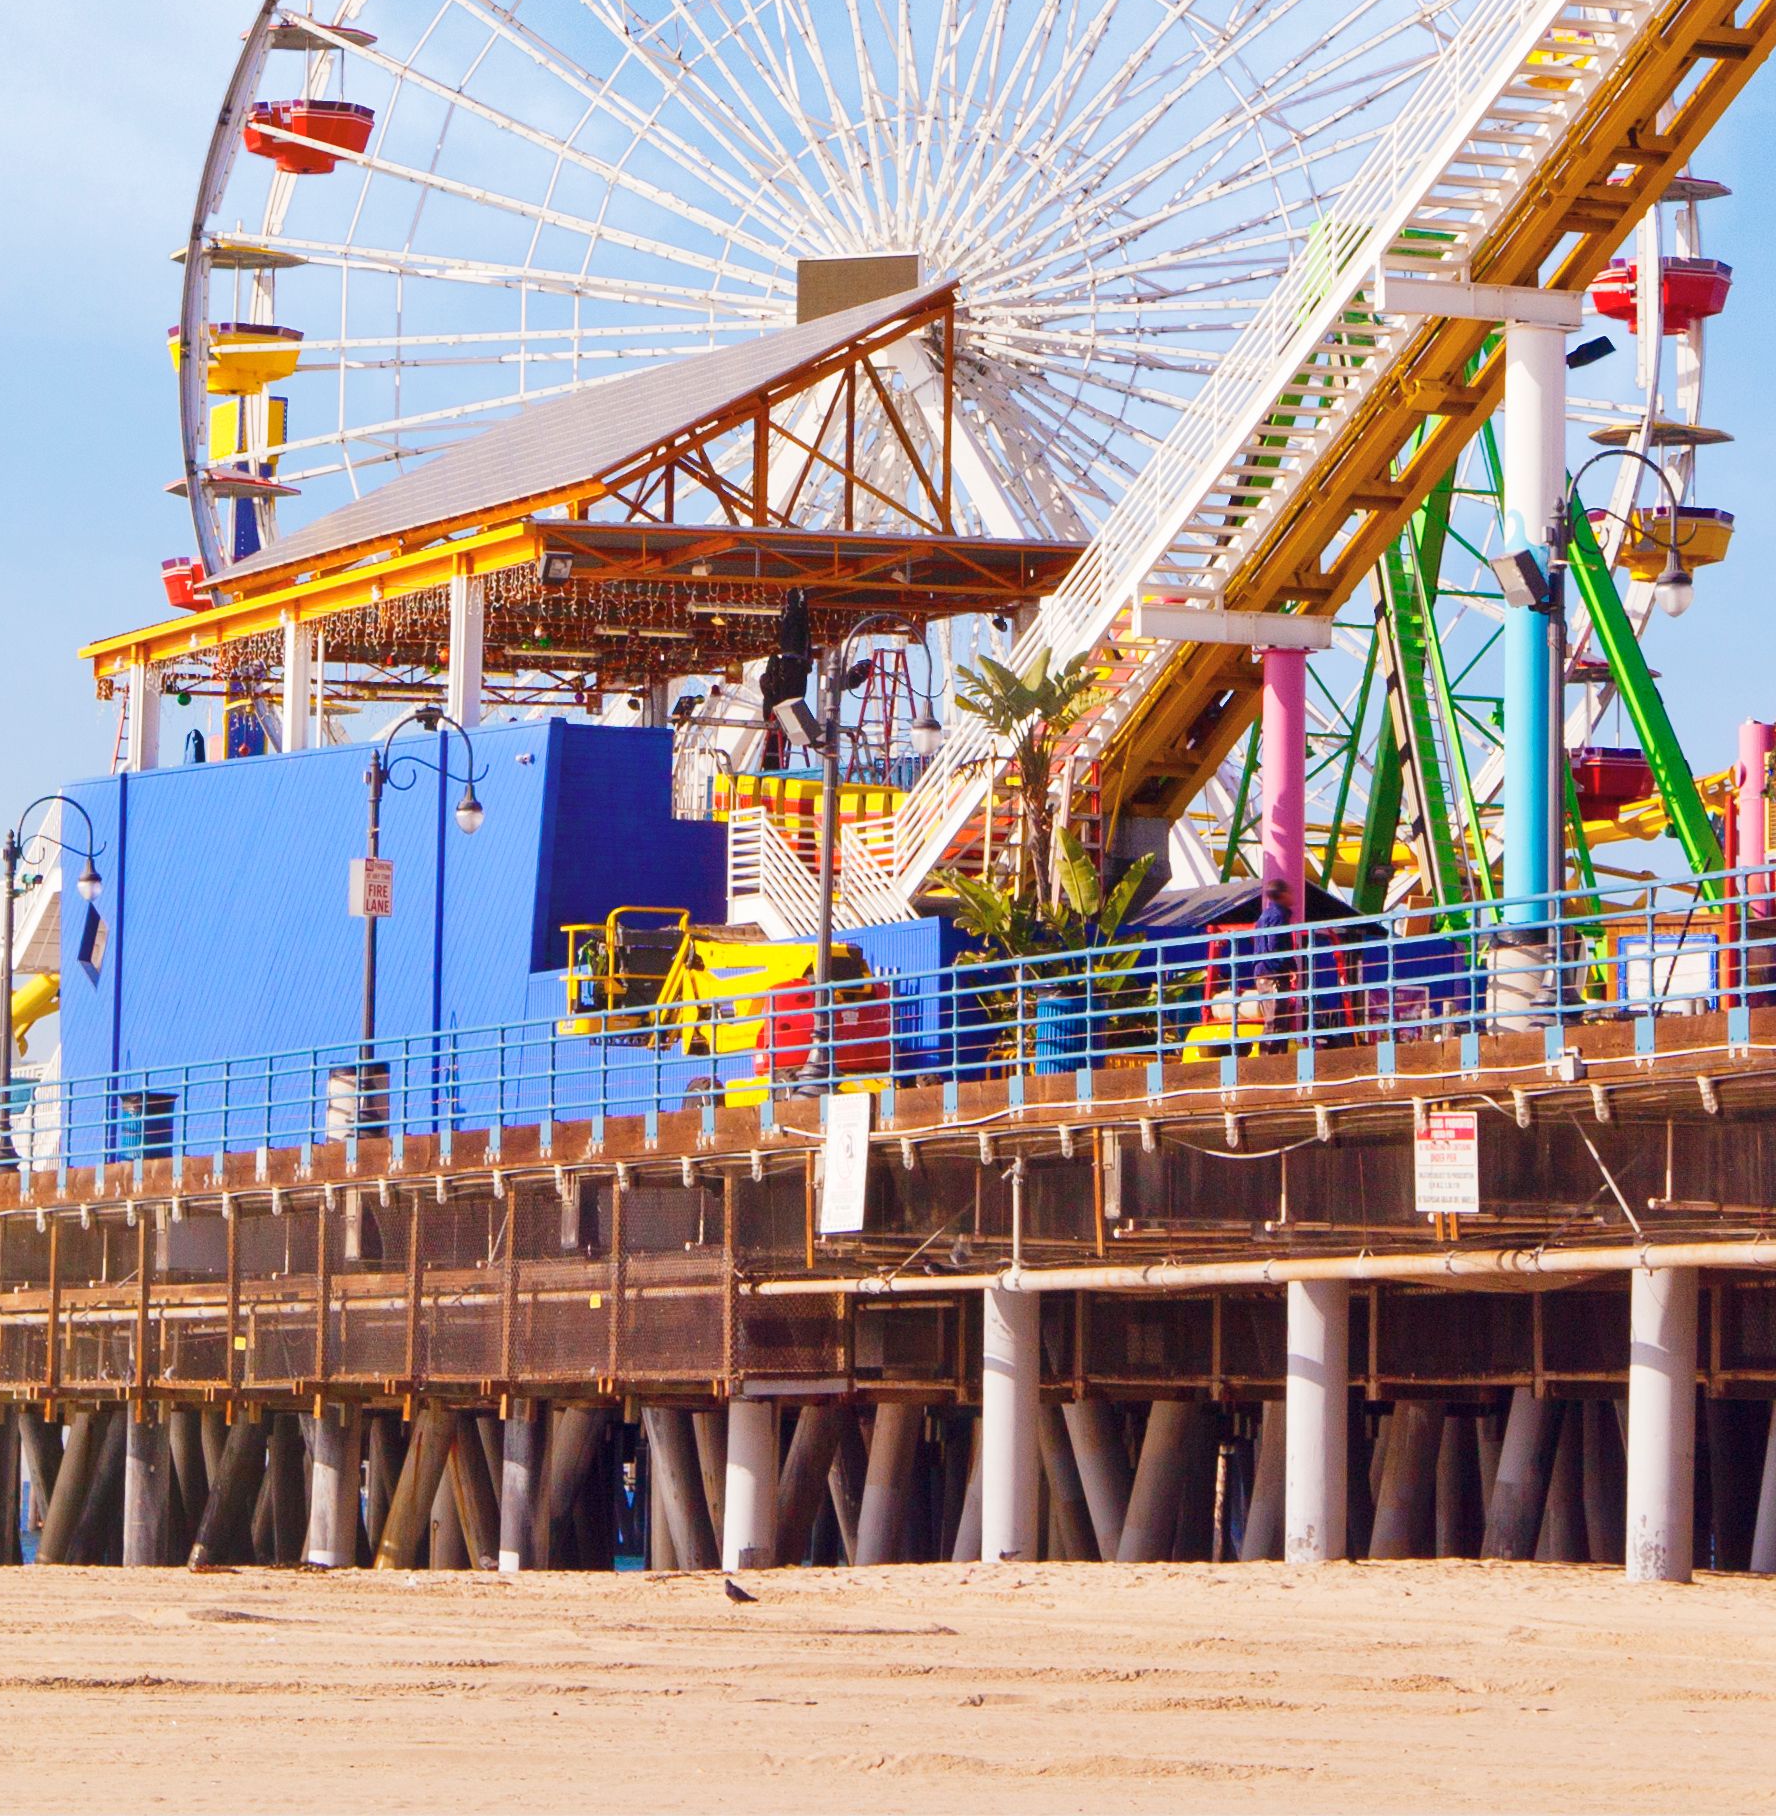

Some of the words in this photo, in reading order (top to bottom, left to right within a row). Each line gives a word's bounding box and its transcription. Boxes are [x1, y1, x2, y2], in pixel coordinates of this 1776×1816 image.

[184, 580, 193, 591] 7
[368, 883, 388, 898] FIRE
[366, 898, 390, 914] LANE
